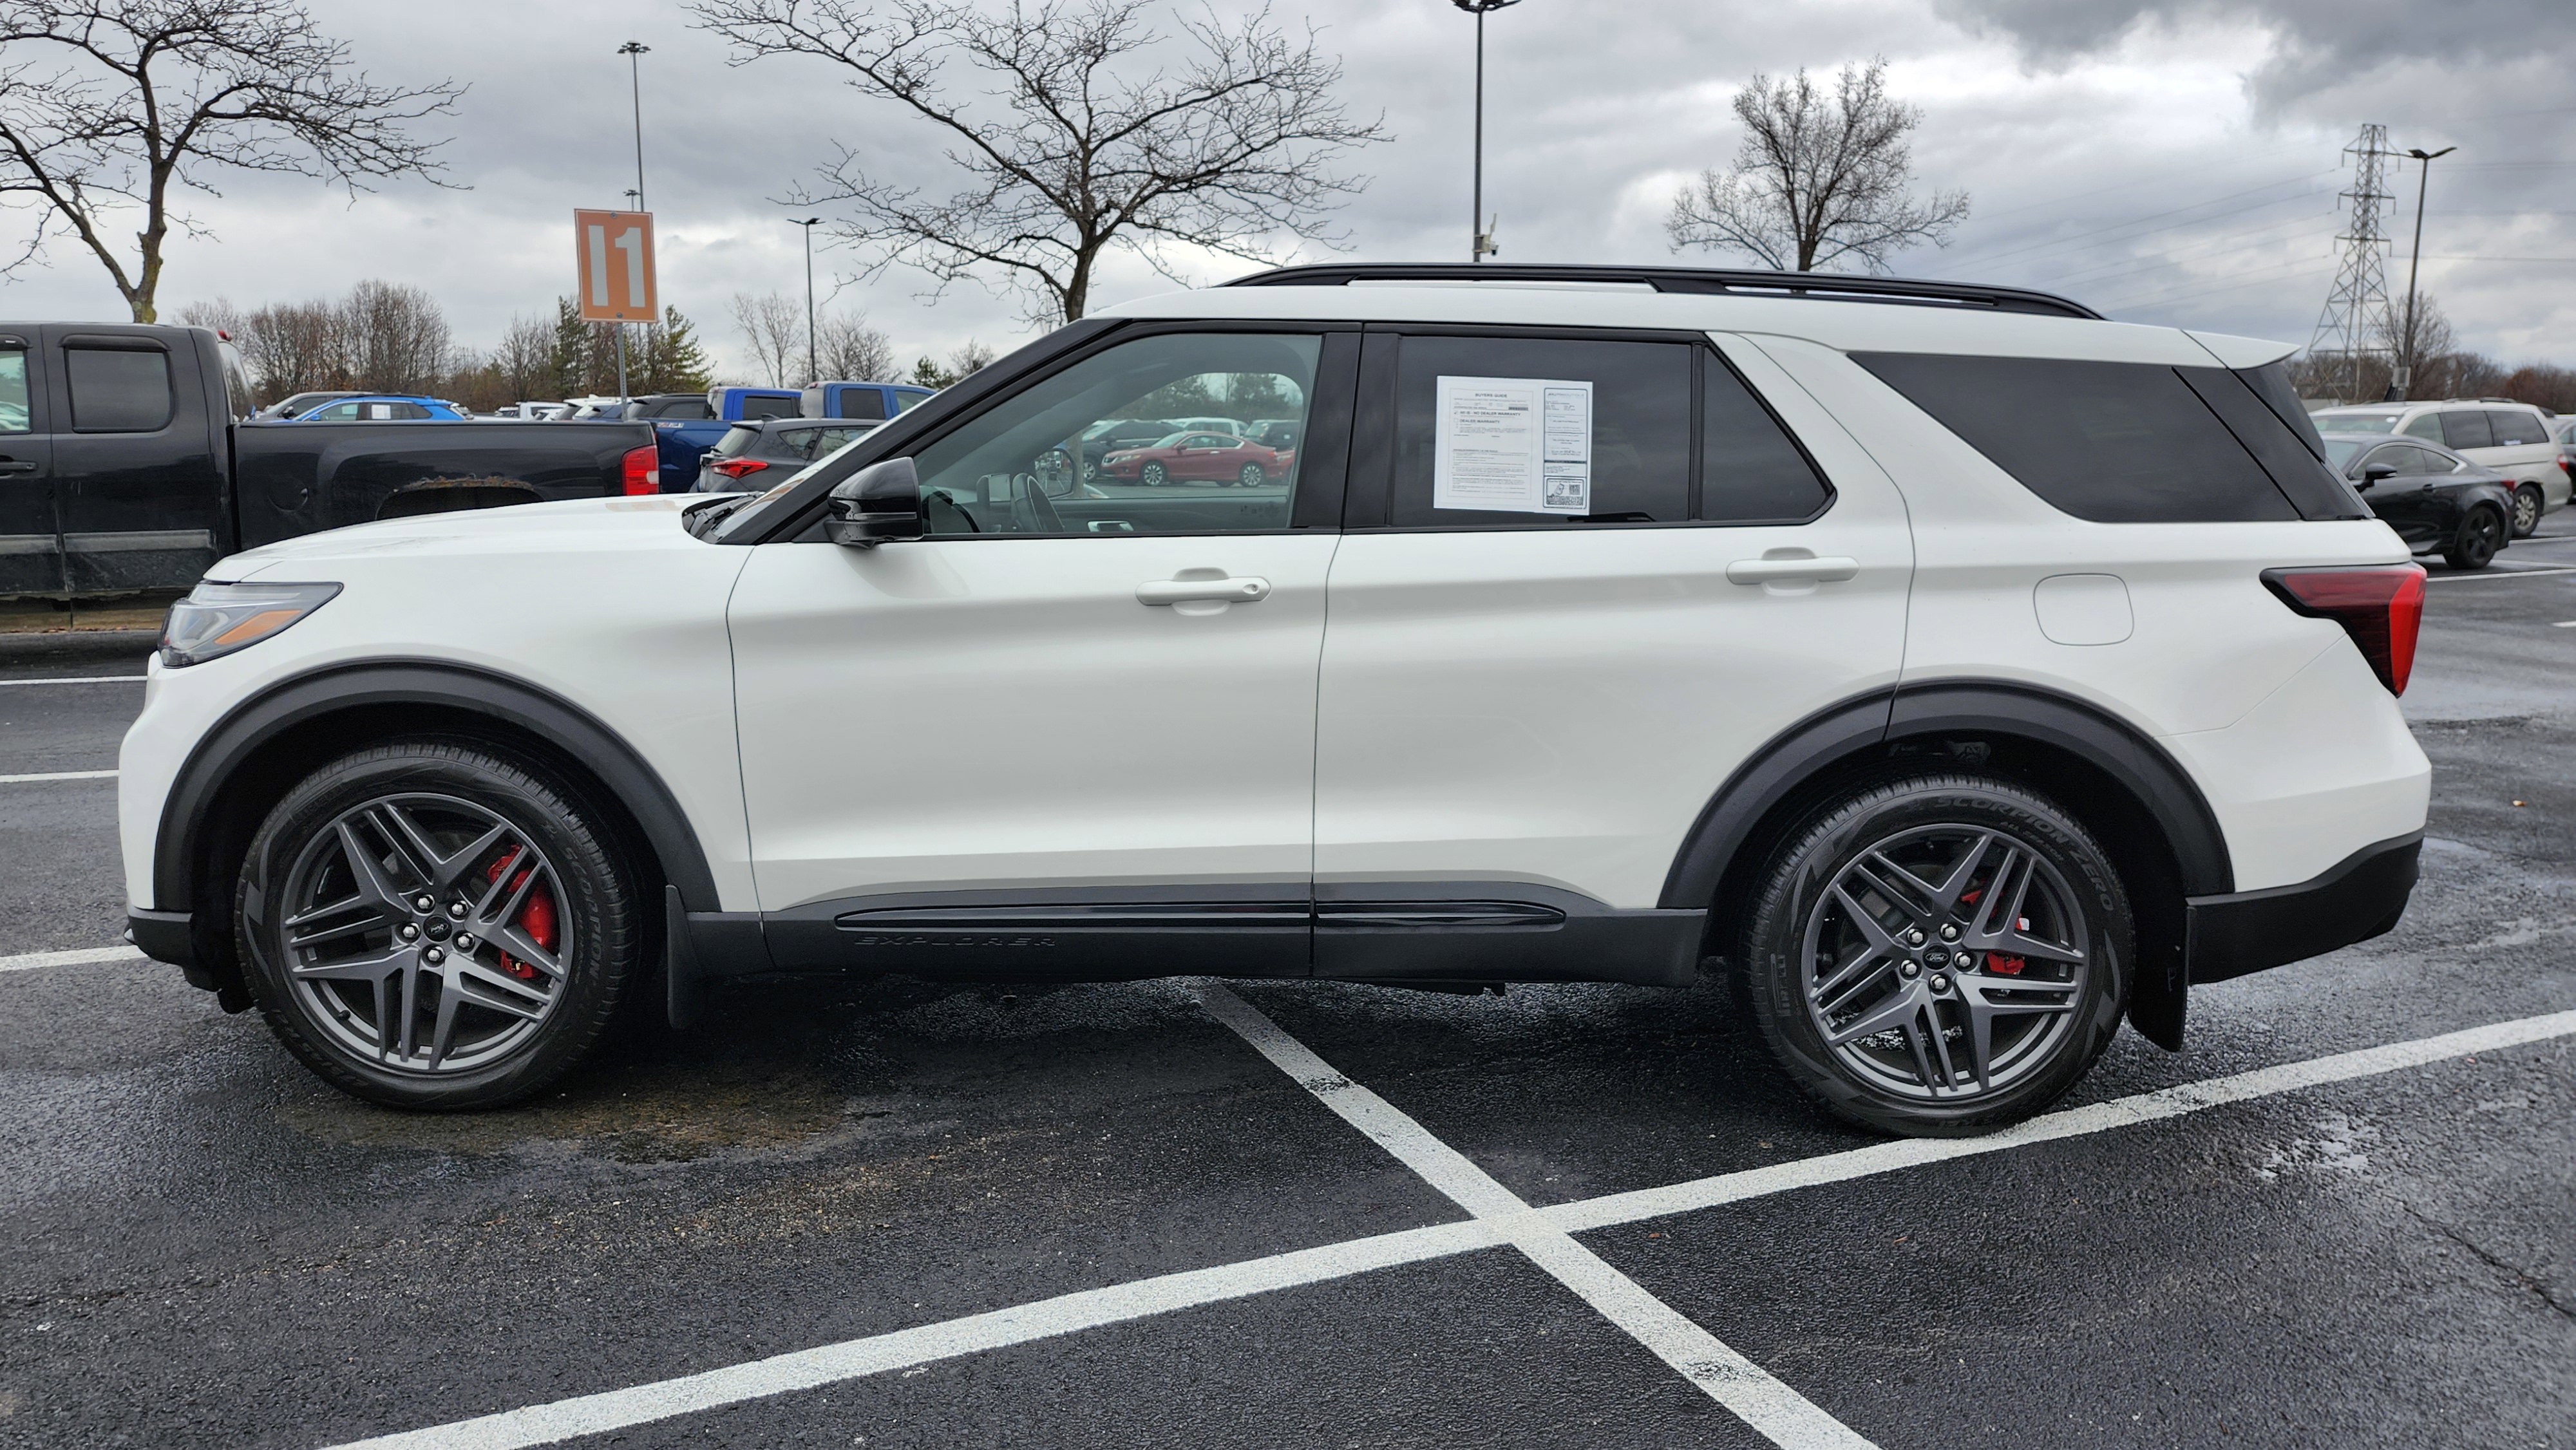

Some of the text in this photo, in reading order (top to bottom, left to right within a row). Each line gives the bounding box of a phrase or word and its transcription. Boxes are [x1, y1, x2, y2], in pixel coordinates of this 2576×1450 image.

[1935, 795, 2114, 912] SCORPION ZERO
[564, 847, 602, 979] SCORPION
[855, 936, 1056, 946] EXPLORER
